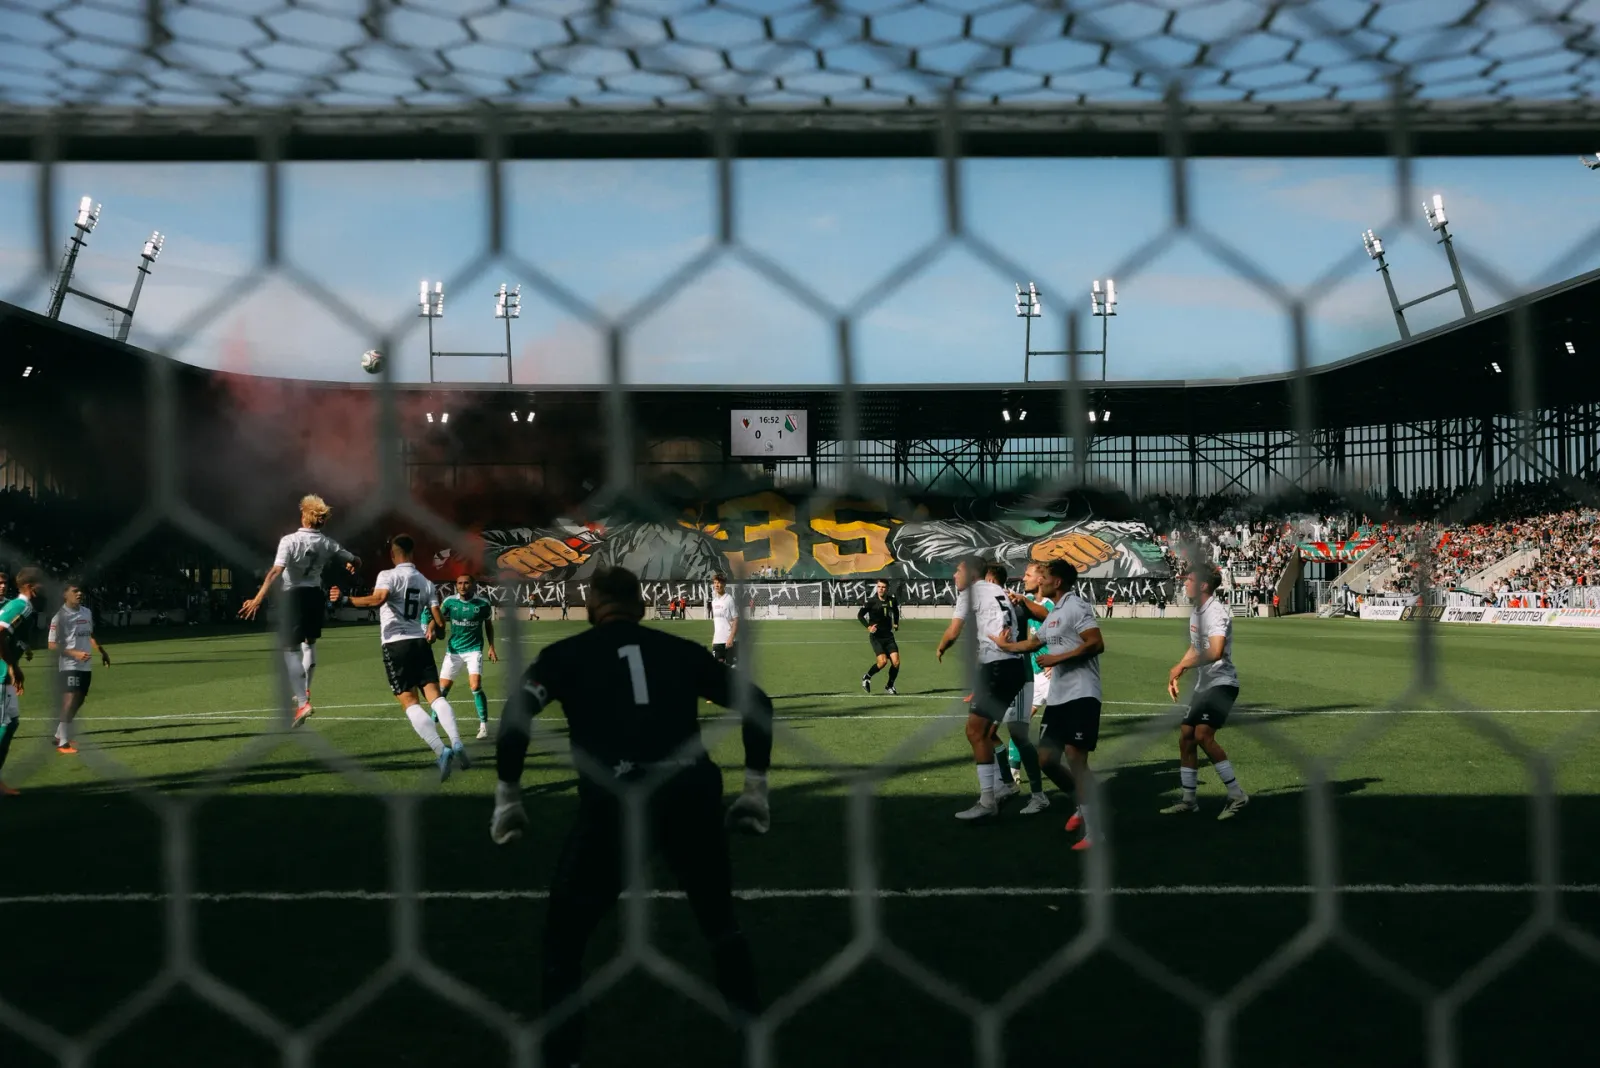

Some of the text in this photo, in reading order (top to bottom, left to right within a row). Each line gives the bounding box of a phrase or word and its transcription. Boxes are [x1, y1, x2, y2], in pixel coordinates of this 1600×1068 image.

[759, 416, 780, 424] 16:52
[755, 430, 782, 440] 0 1
[640, 582, 722, 602] KOLEJN
[404, 588, 420, 619] 6
[1456, 609, 1487, 622] hummel
[1492, 609, 1546, 623] interpromex
[617, 644, 649, 705] 1
